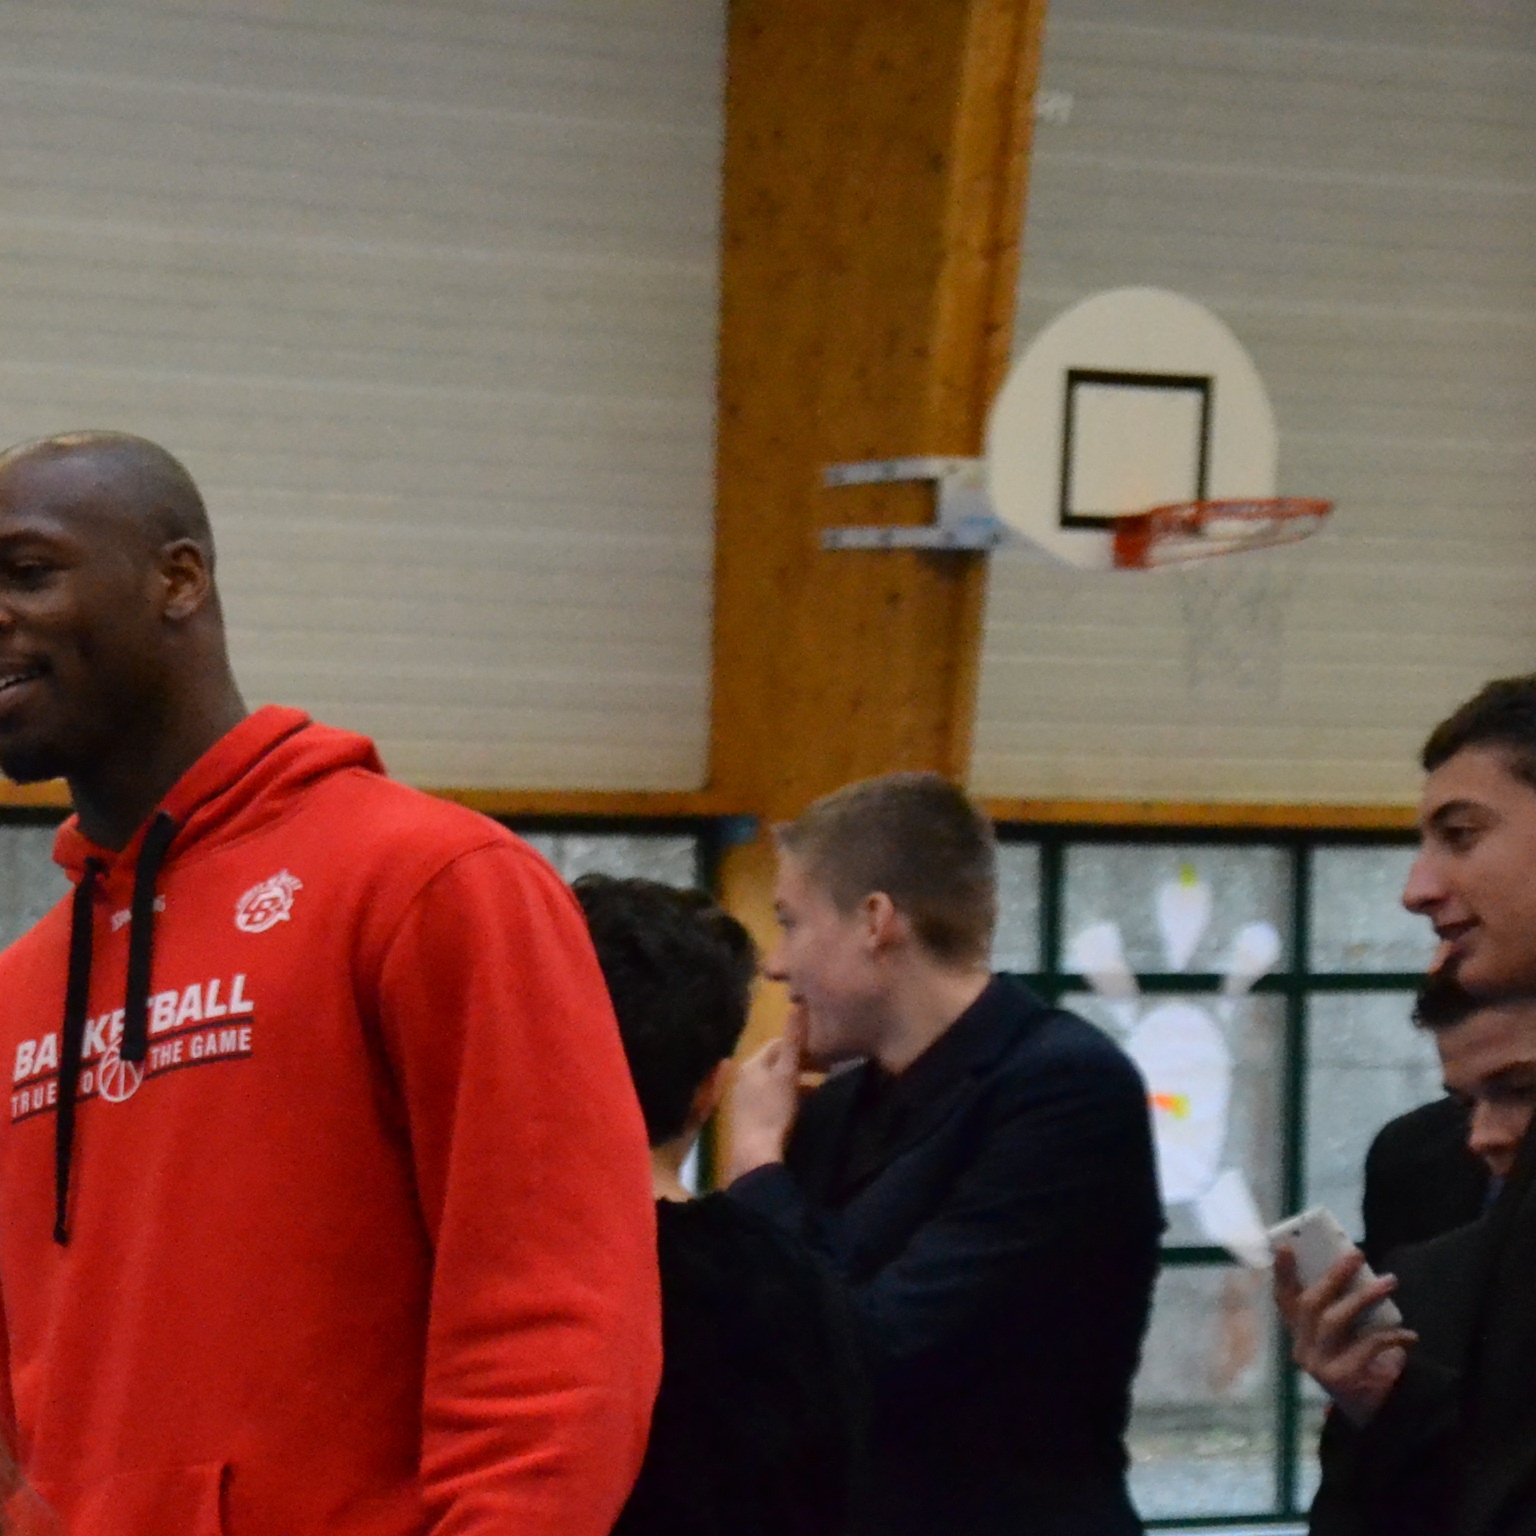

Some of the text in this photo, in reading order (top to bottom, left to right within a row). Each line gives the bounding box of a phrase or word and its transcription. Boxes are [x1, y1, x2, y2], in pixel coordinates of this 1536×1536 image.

[11, 1080, 59, 1119] TRUE
[150, 1040, 184, 1069] THE
[190, 1027, 253, 1059] GAME
[13, 974, 255, 1081] BAKEBALL
